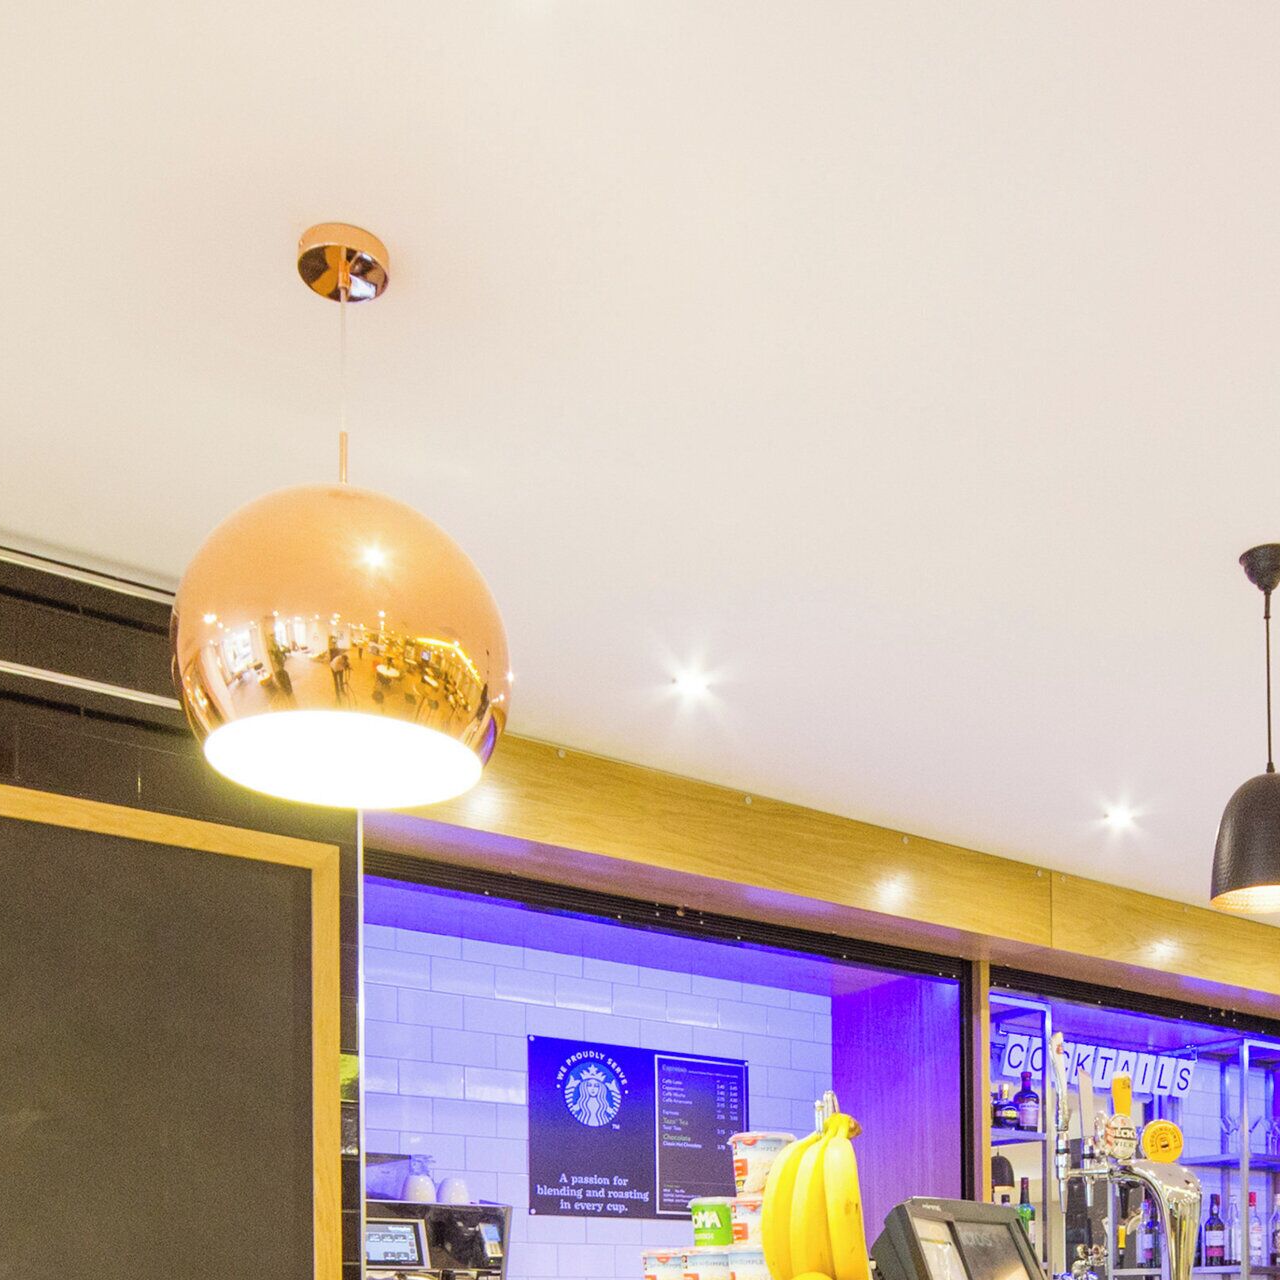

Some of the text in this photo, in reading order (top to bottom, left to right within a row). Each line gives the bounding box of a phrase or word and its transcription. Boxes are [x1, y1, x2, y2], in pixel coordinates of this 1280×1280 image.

[556, 1050, 628, 1085] WE PROUDLY SERVE
[559, 1173, 629, 1186] A passion for
[536, 1184, 584, 1199] blending
[585, 1188, 606, 1198] and
[607, 1189, 650, 1202] roasting
[560, 1199, 629, 1213] in every cup.
